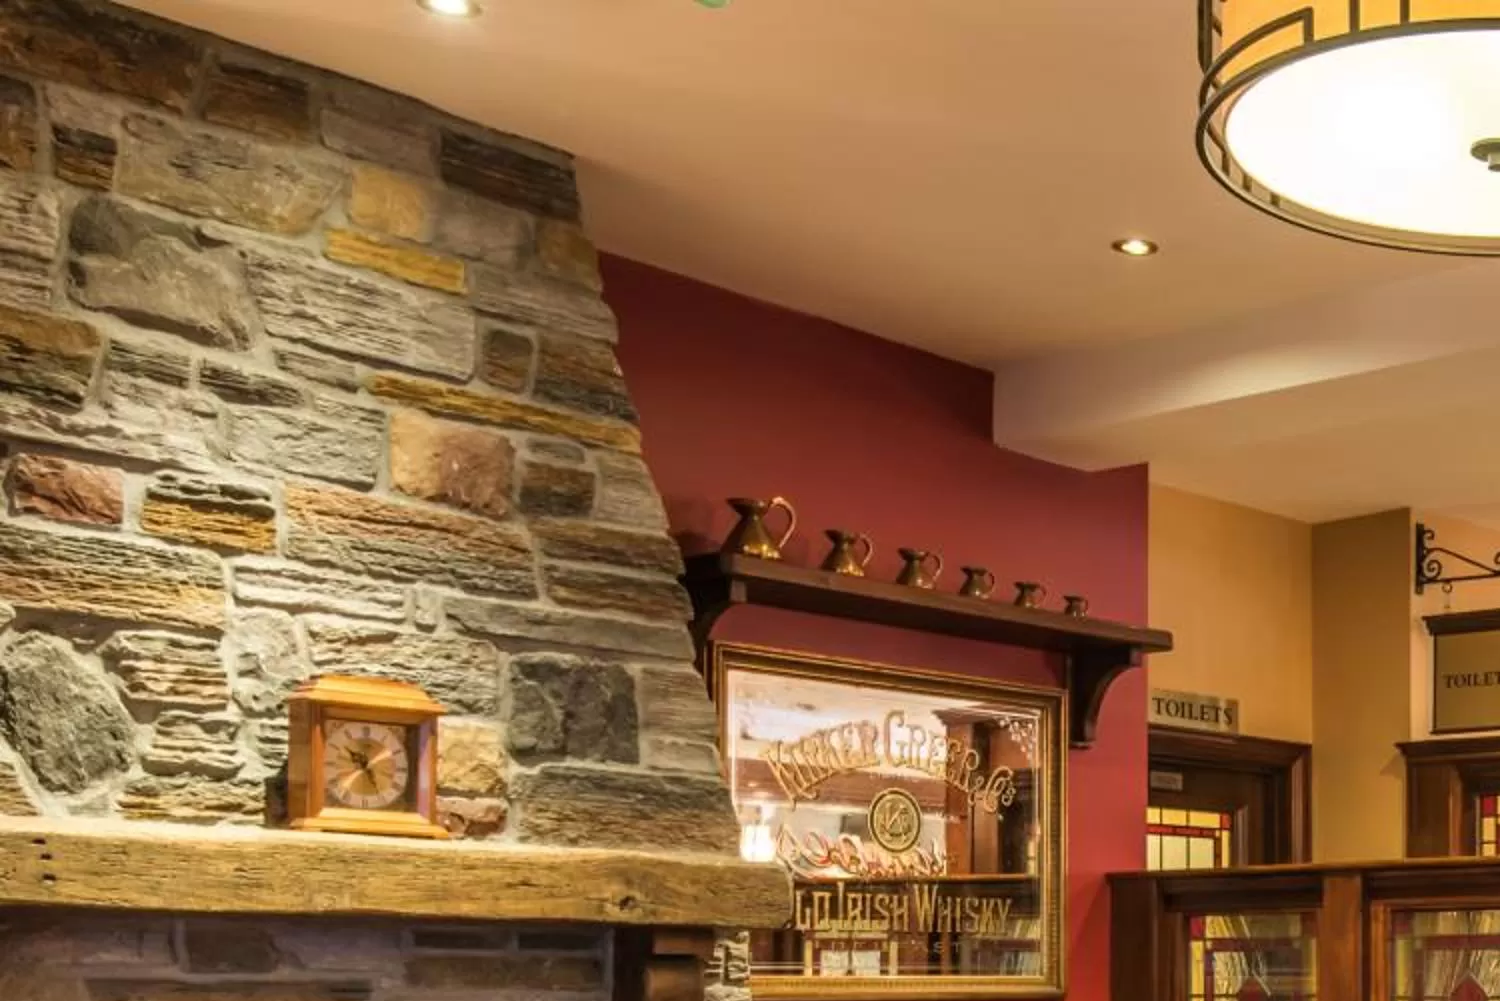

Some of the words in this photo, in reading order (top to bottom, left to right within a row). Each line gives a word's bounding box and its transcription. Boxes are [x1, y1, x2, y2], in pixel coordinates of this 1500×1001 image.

[1151, 697, 1233, 727] TOILETS
[794, 888, 832, 932] LD
[834, 881, 909, 933] IRISH
[913, 883, 1013, 935] WHISKY
